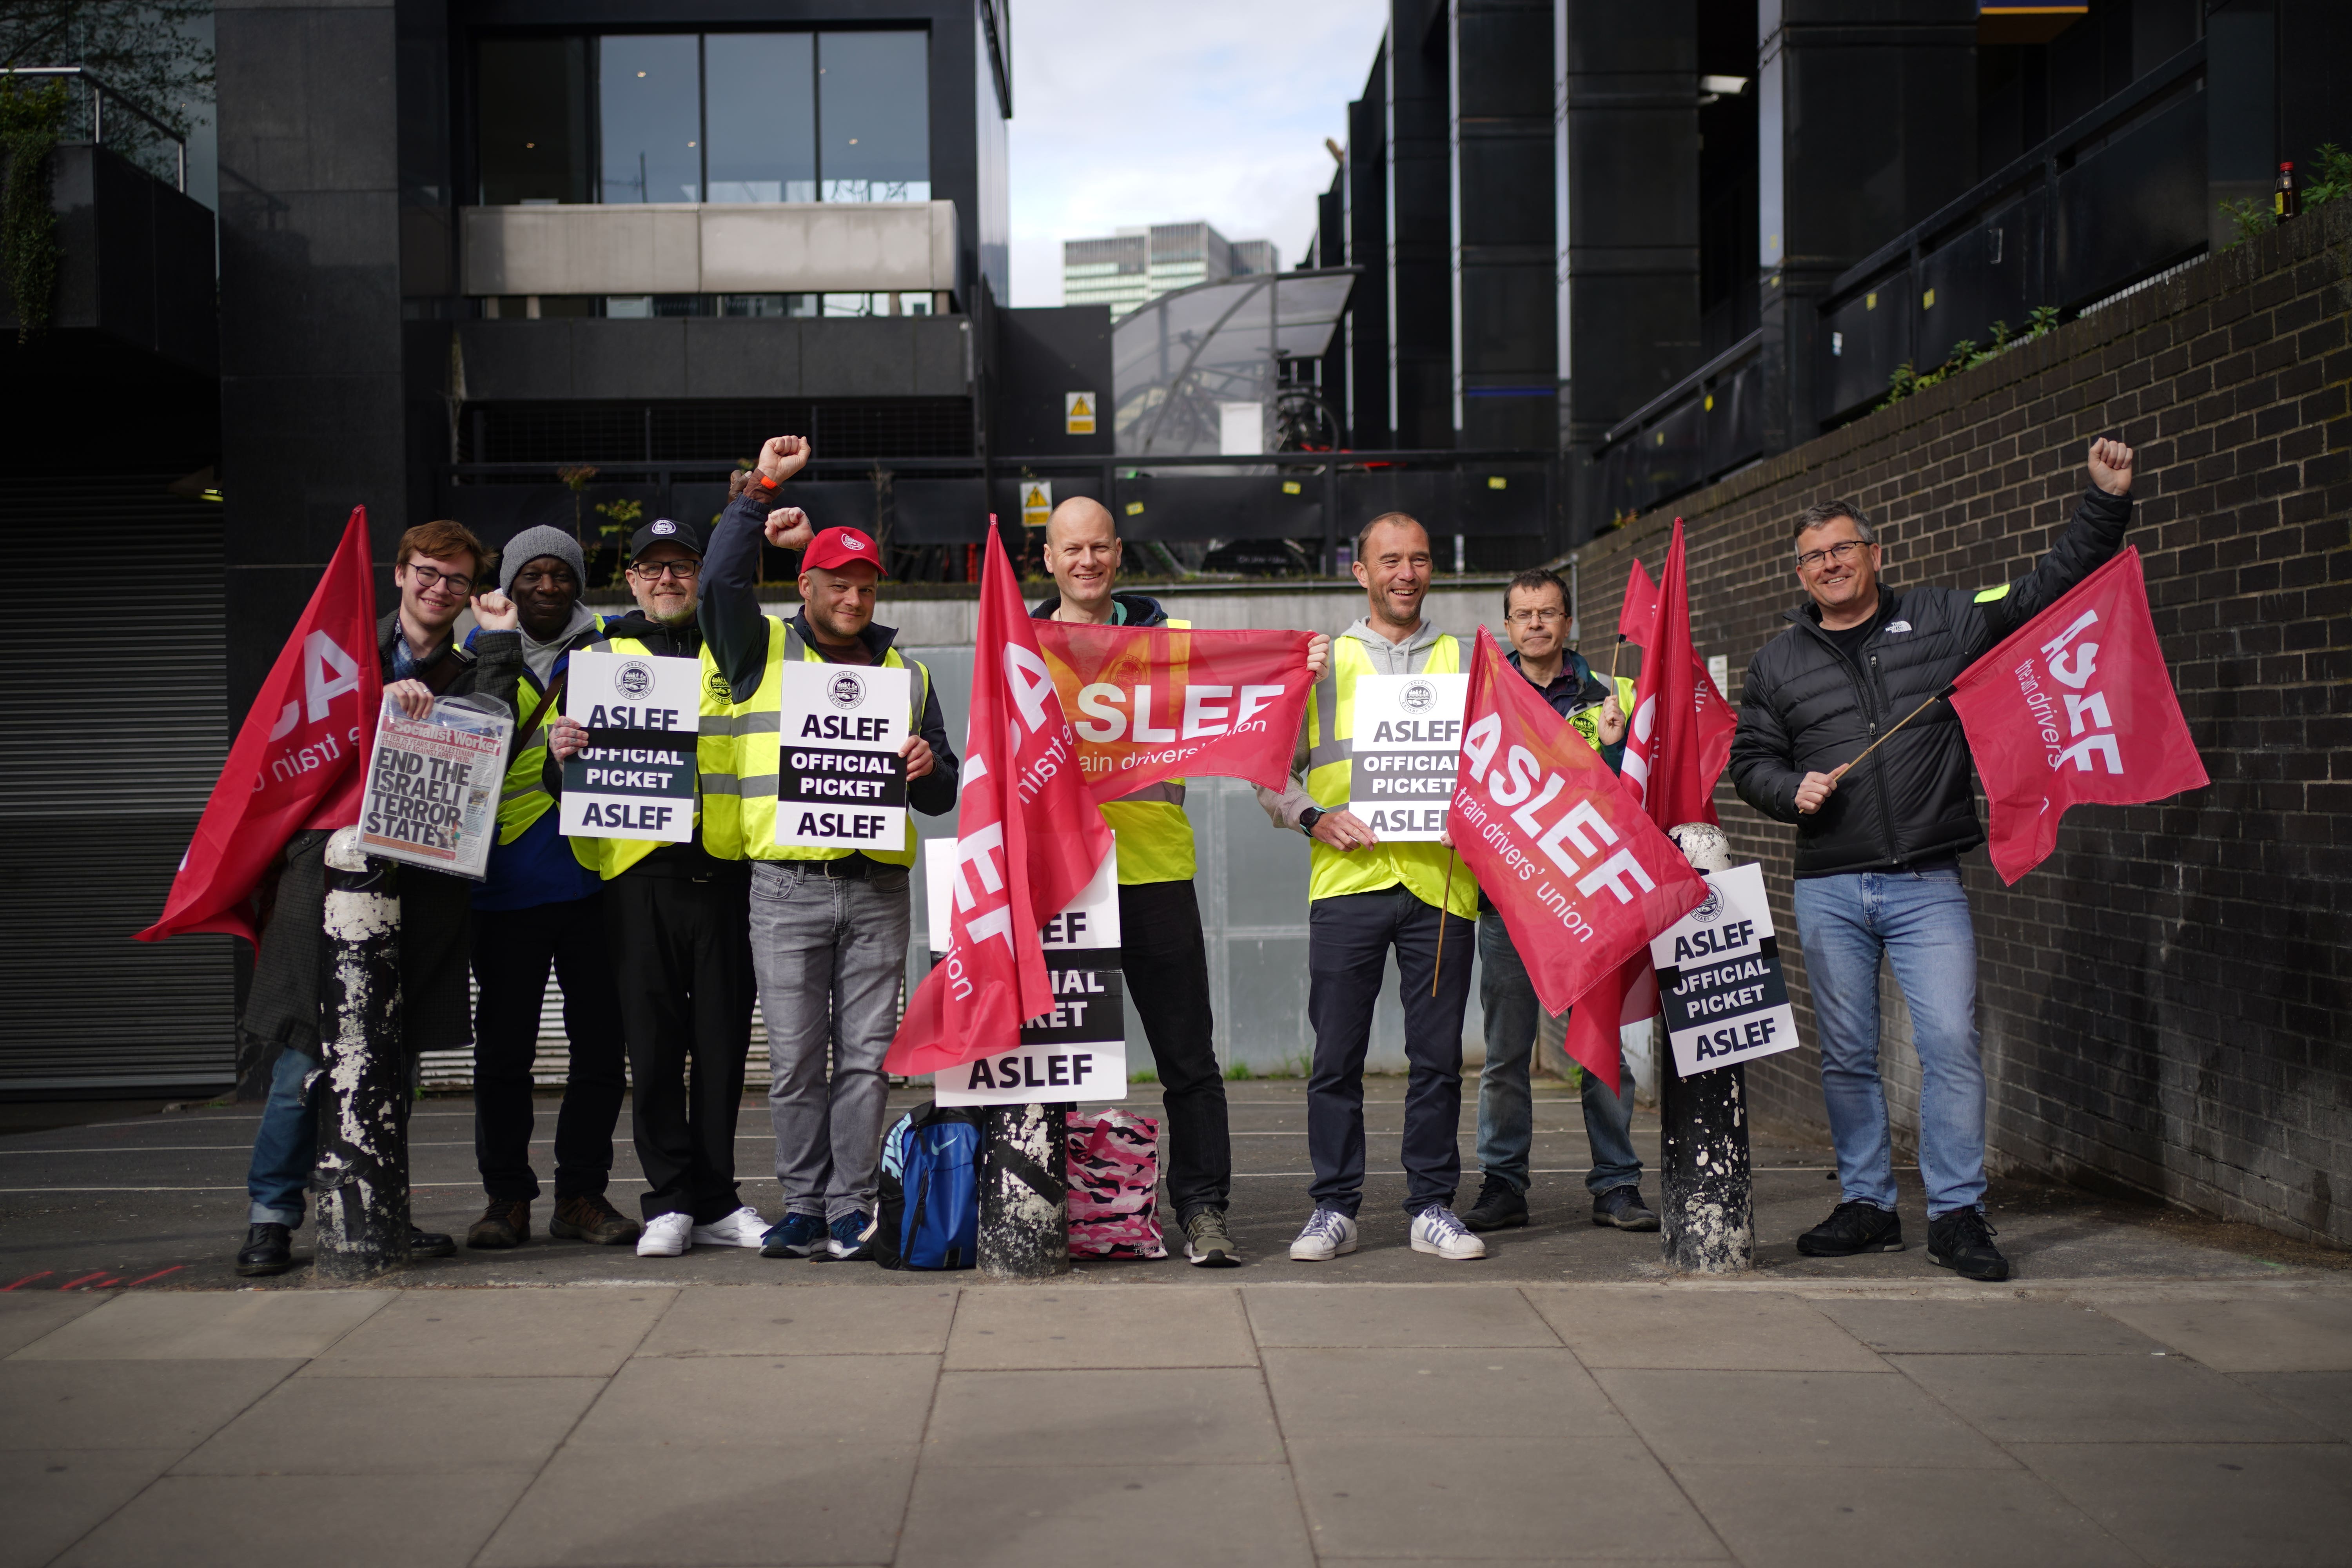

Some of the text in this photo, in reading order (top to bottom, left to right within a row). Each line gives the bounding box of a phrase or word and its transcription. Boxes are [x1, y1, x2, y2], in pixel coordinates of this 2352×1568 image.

[851, 698, 862, 707] 1880
[2040, 609, 2124, 774] ASEF
[588, 704, 679, 730] ASLEF
[1075, 683, 1285, 742] SLEF
[394, 719, 501, 753] Socialist Worker
[801, 714, 889, 742] ASLEF
[1373, 720, 1460, 742] ASLEF
[381, 739, 411, 751] STRUGGLE
[412, 746, 437, 757] AGAINST
[382, 733, 400, 742] AFTER
[410, 739, 429, 749] YEARS
[438, 745, 475, 759] PALESTINIAN
[577, 747, 684, 766] OFFICIAL
[376, 746, 423, 775] END
[429, 757, 472, 786] THE
[791, 753, 896, 774] OFFICIAL
[1079, 751, 1112, 772] ain
[372, 768, 461, 806] ISRAELI
[586, 768, 673, 789] PICKET
[800, 778, 885, 798] PICKET
[1372, 778, 1457, 793] PICKET
[371, 789, 463, 829] TERROR
[582, 803, 672, 830] ASLEF
[1463, 712, 1656, 905] ASLEF
[365, 812, 438, 846] STATE
[797, 812, 886, 839] ASLEF
[1455, 787, 1487, 828] train
[1536, 882, 1593, 943] union
[1713, 906, 1722, 918] 1880
[1675, 920, 1754, 962] ASLEF
[1673, 958, 1771, 996] OFFICIAL
[1686, 984, 1764, 1018] PICKET
[1697, 1017, 1776, 1062] ASLEF
[968, 1054, 1093, 1090] ASLEF
